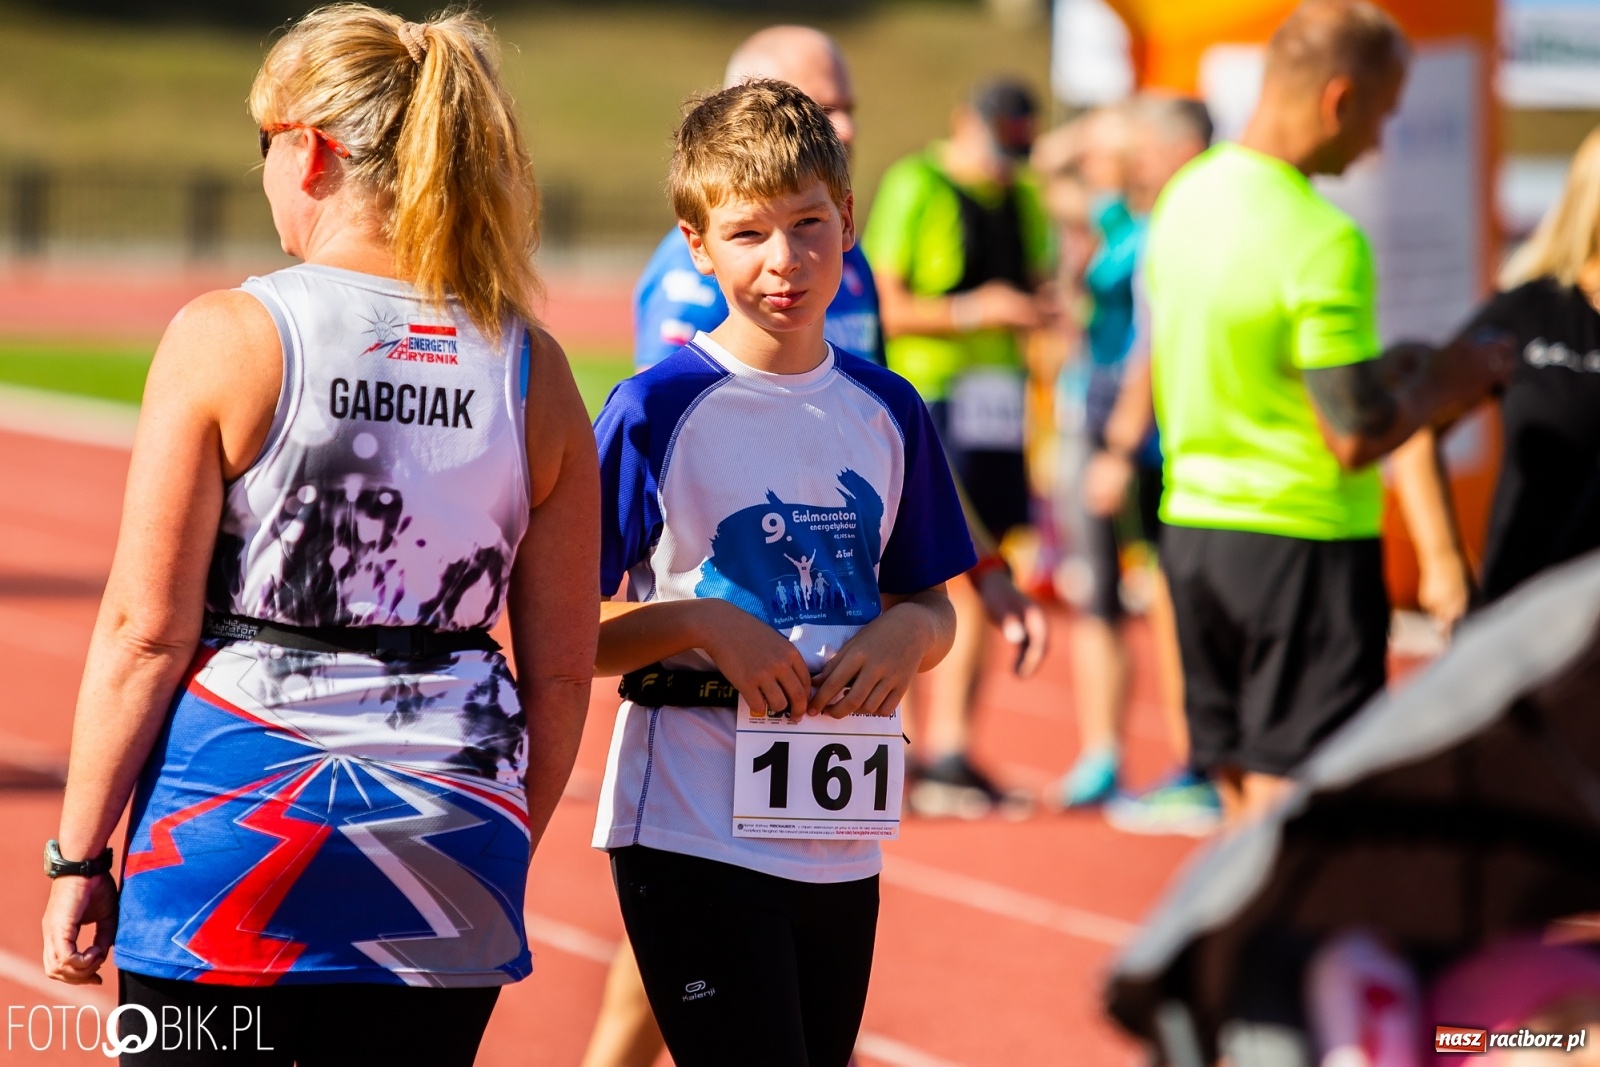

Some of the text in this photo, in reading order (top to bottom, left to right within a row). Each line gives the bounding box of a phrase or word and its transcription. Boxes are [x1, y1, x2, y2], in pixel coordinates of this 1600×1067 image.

[408, 337, 458, 354] ENERGETYK
[408, 352, 459, 365] RYBNIK
[330, 377, 476, 429] GABCIAK
[809, 522, 857, 532] energetyków
[753, 741, 889, 811] 161
[682, 988, 716, 1002] Kalenji
